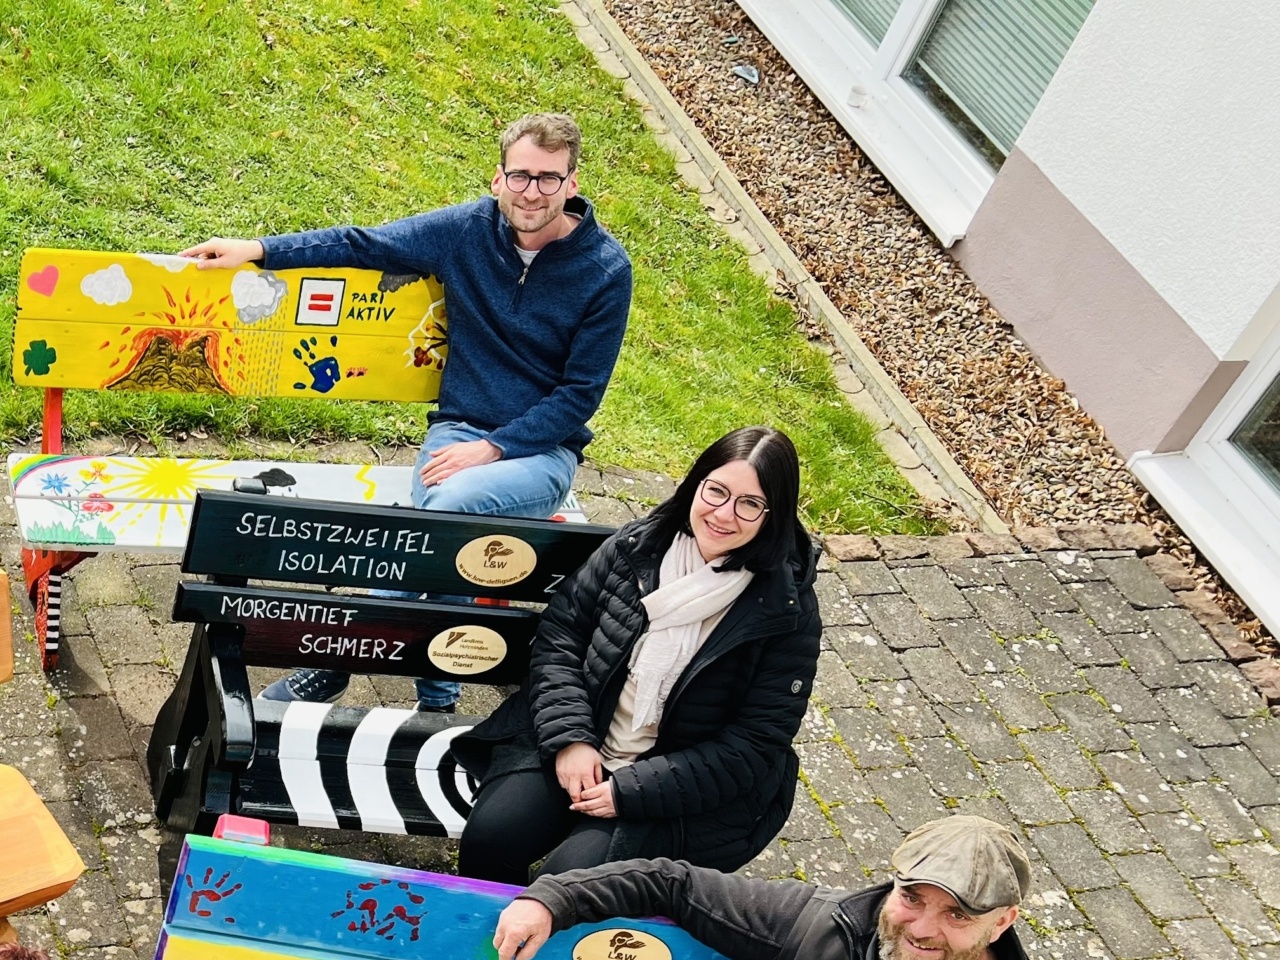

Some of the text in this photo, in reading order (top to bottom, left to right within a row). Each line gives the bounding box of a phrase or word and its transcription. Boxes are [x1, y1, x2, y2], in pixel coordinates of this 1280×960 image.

[351, 292, 384, 305] PARI
[346, 306, 396, 322] AKTIV
[236, 512, 435, 555] SELBSTZWEIFEL
[278, 550, 407, 581] ISOLATION
[483, 560, 507, 569] L&W
[220, 595, 359, 627] MORGENTIEF
[298, 633, 406, 661] SCHMERZ
[432, 651, 499, 662] Sozialpsychiatrischer
[452, 661, 473, 669] Dienst
